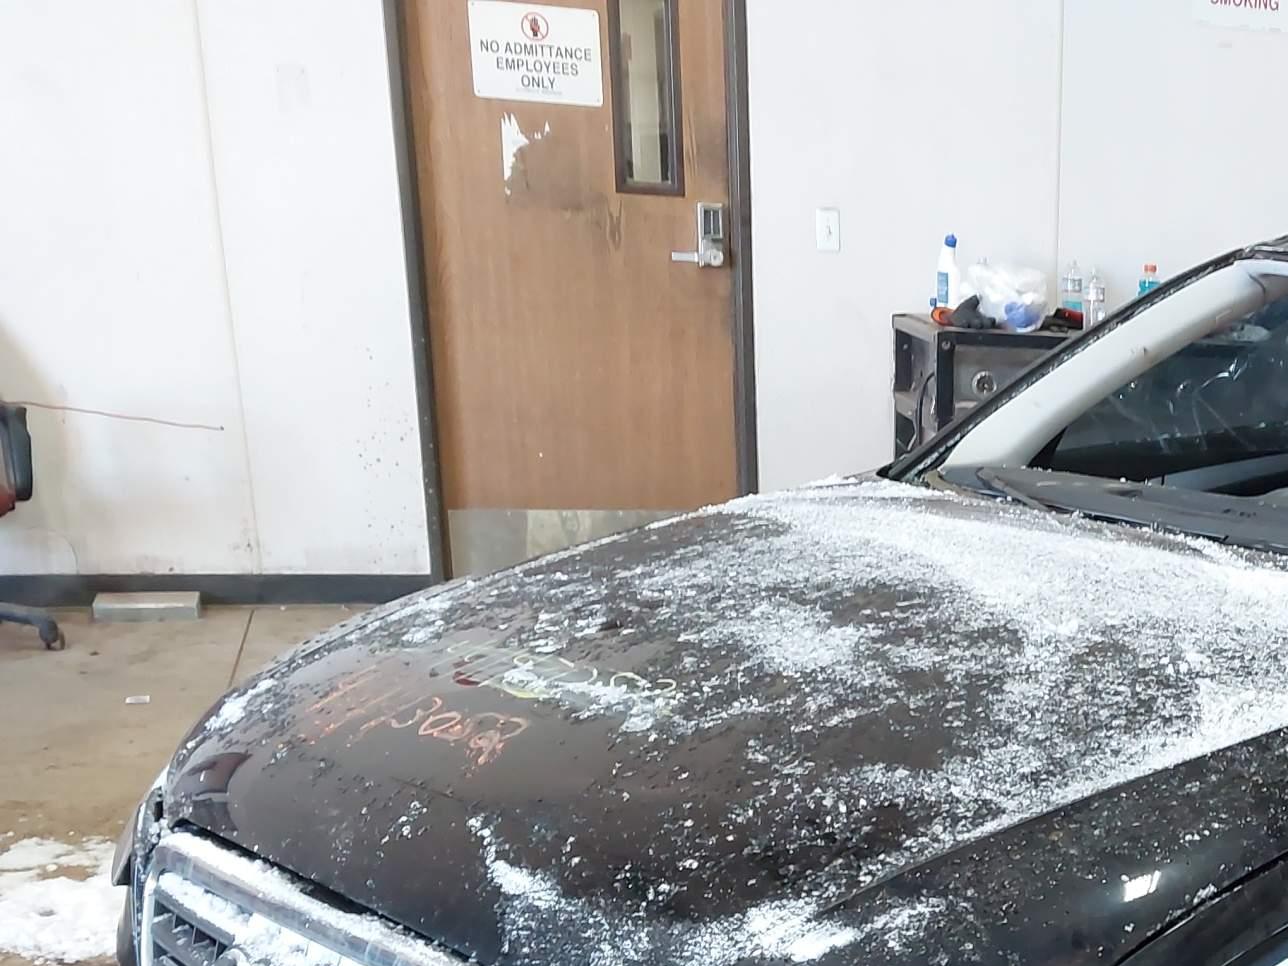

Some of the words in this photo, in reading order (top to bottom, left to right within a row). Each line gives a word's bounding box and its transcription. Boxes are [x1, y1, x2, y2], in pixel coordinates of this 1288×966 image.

[479, 39, 500, 53] NO
[504, 42, 592, 62] ADMITTANCE
[496, 56, 579, 77] EMPLOYEES
[520, 73, 556, 90] ONLY
